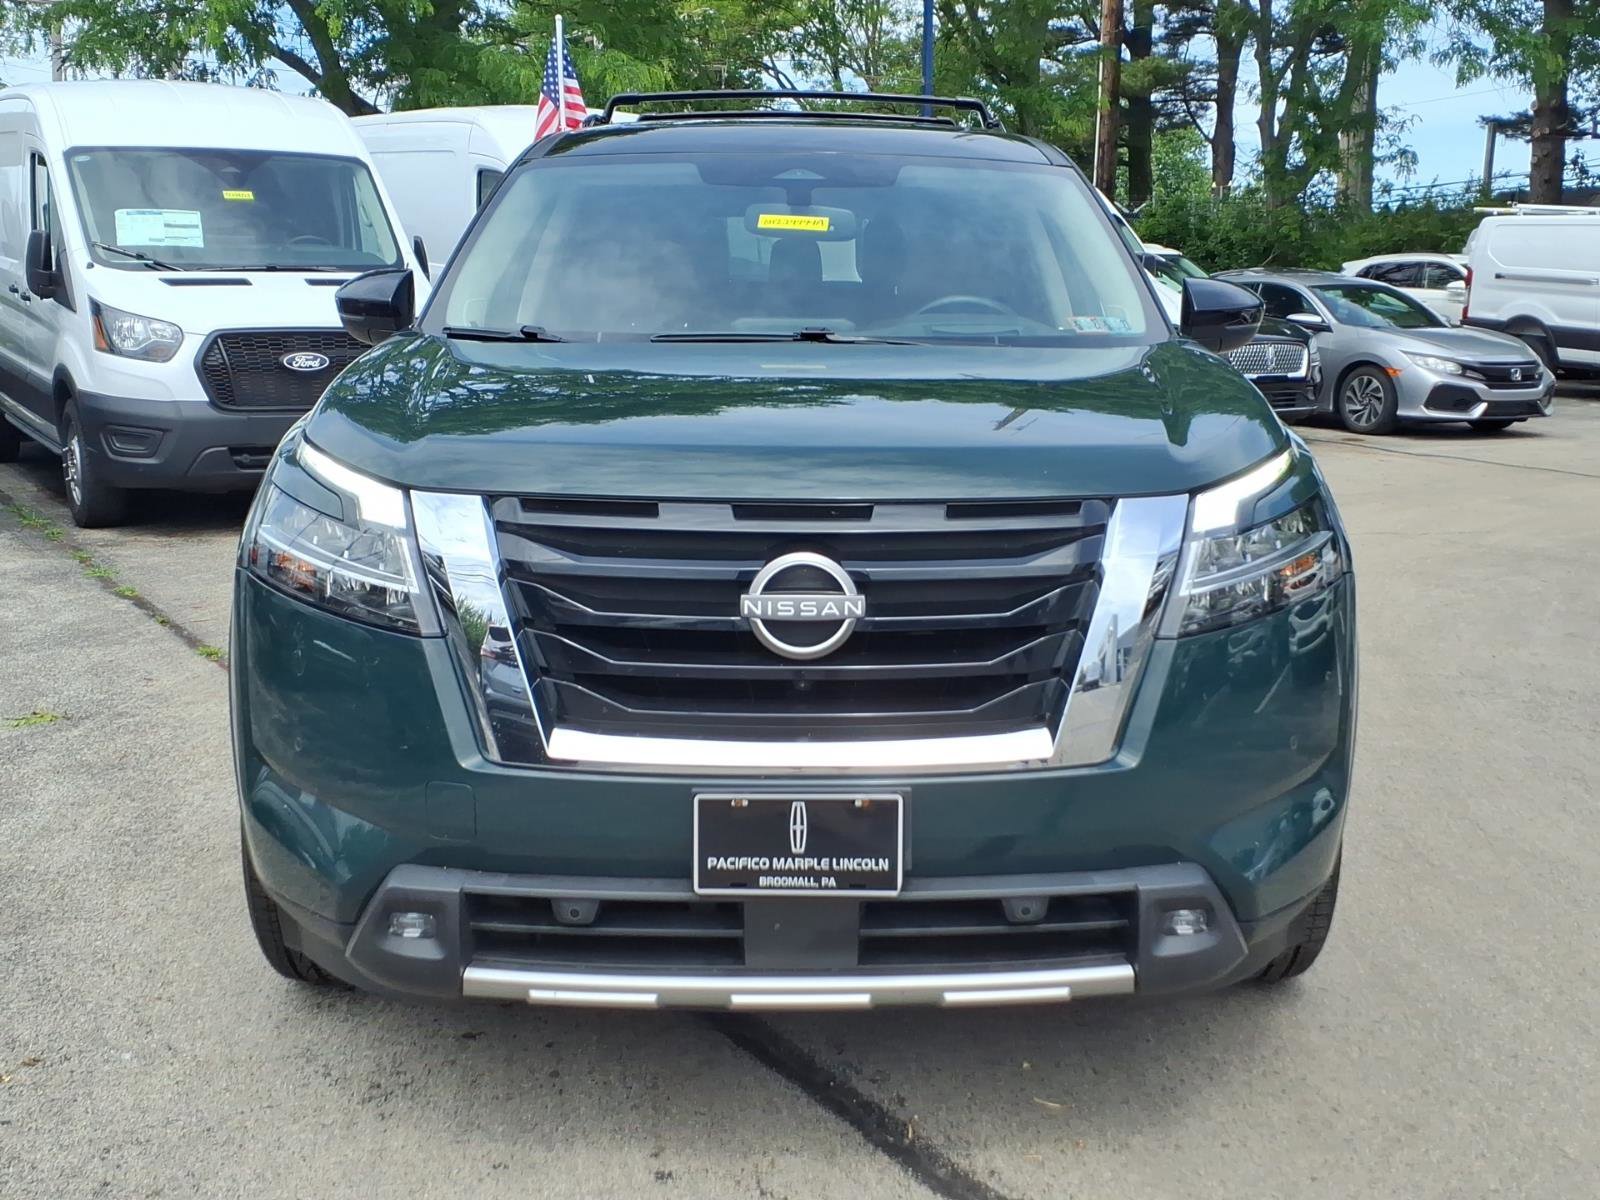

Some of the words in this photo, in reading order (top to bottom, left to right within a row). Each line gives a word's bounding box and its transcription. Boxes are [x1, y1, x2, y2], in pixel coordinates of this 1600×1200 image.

[292, 355, 321, 368] Ford
[744, 600, 862, 616] NISSAN
[707, 857, 770, 871] PACIFICO
[772, 857, 830, 871] MARPLE
[832, 857, 889, 872] LINCOLN
[821, 876, 837, 888] PA
